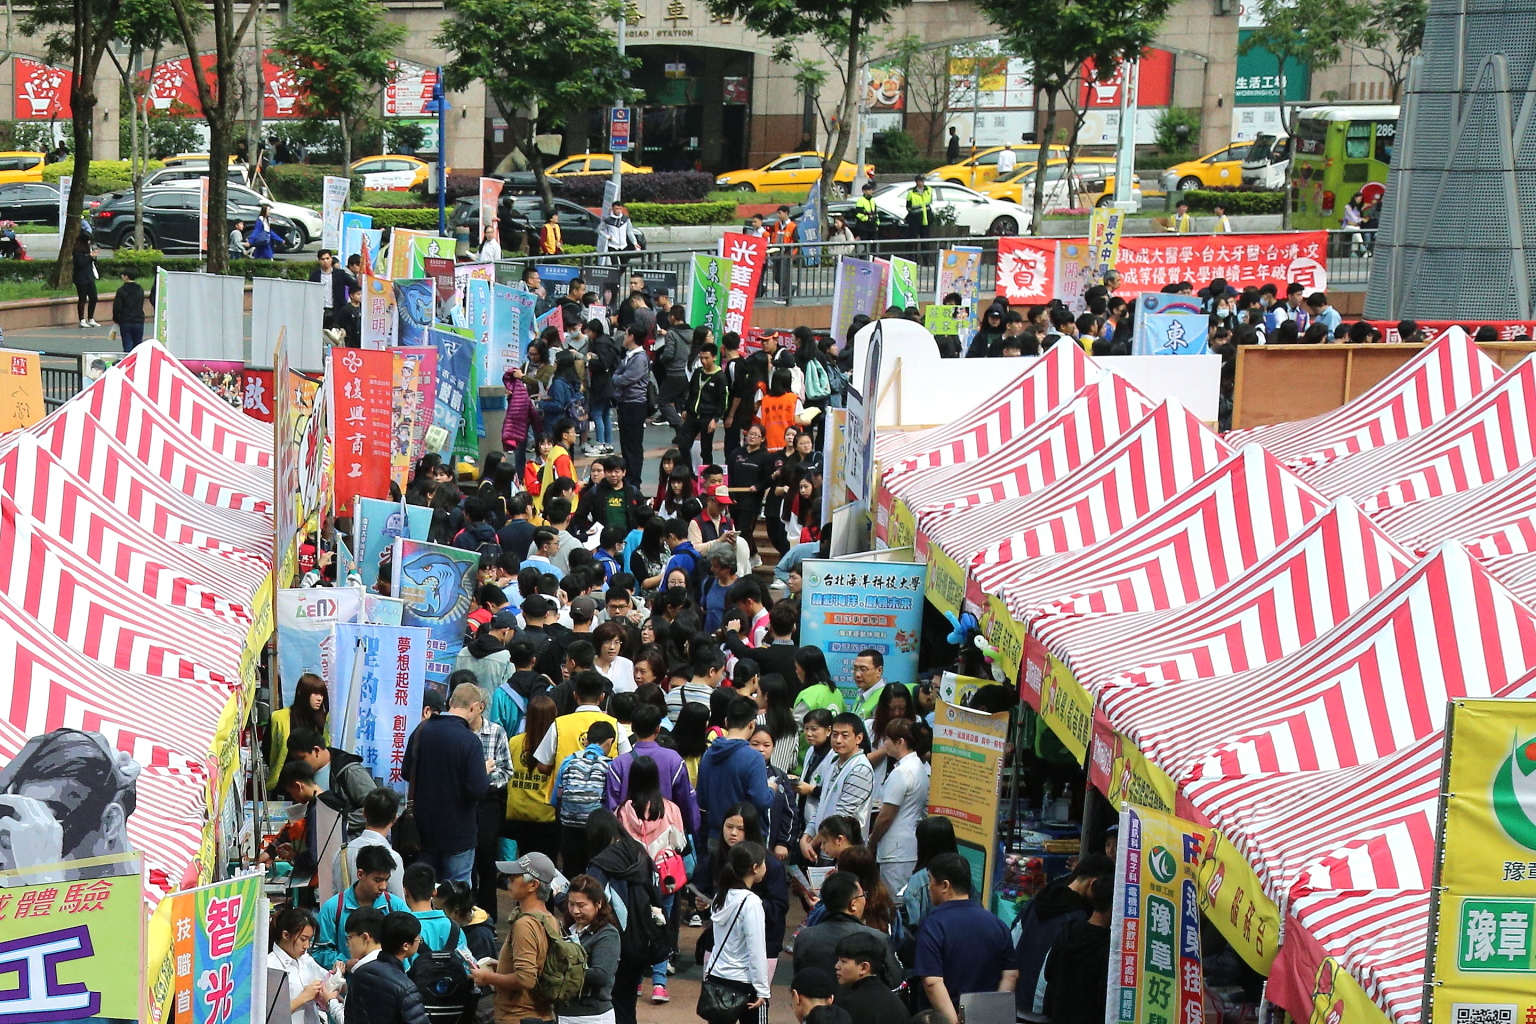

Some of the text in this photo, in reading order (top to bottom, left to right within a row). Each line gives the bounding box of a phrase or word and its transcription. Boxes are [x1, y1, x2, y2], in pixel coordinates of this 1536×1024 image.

[1012, 256, 1038, 290] 賀
[1165, 319, 1189, 350] 東
[244, 376, 270, 415] 啟
[344, 378, 366, 478] 復興商工
[823, 573, 921, 591] 台北海洋科技大學
[389, 636, 411, 783] 夢想起飛 創意未來
[1129, 852, 1138, 883] 電子科
[1231, 886, 1266, 958] 服務台
[1465, 909, 1529, 962] 豫章
